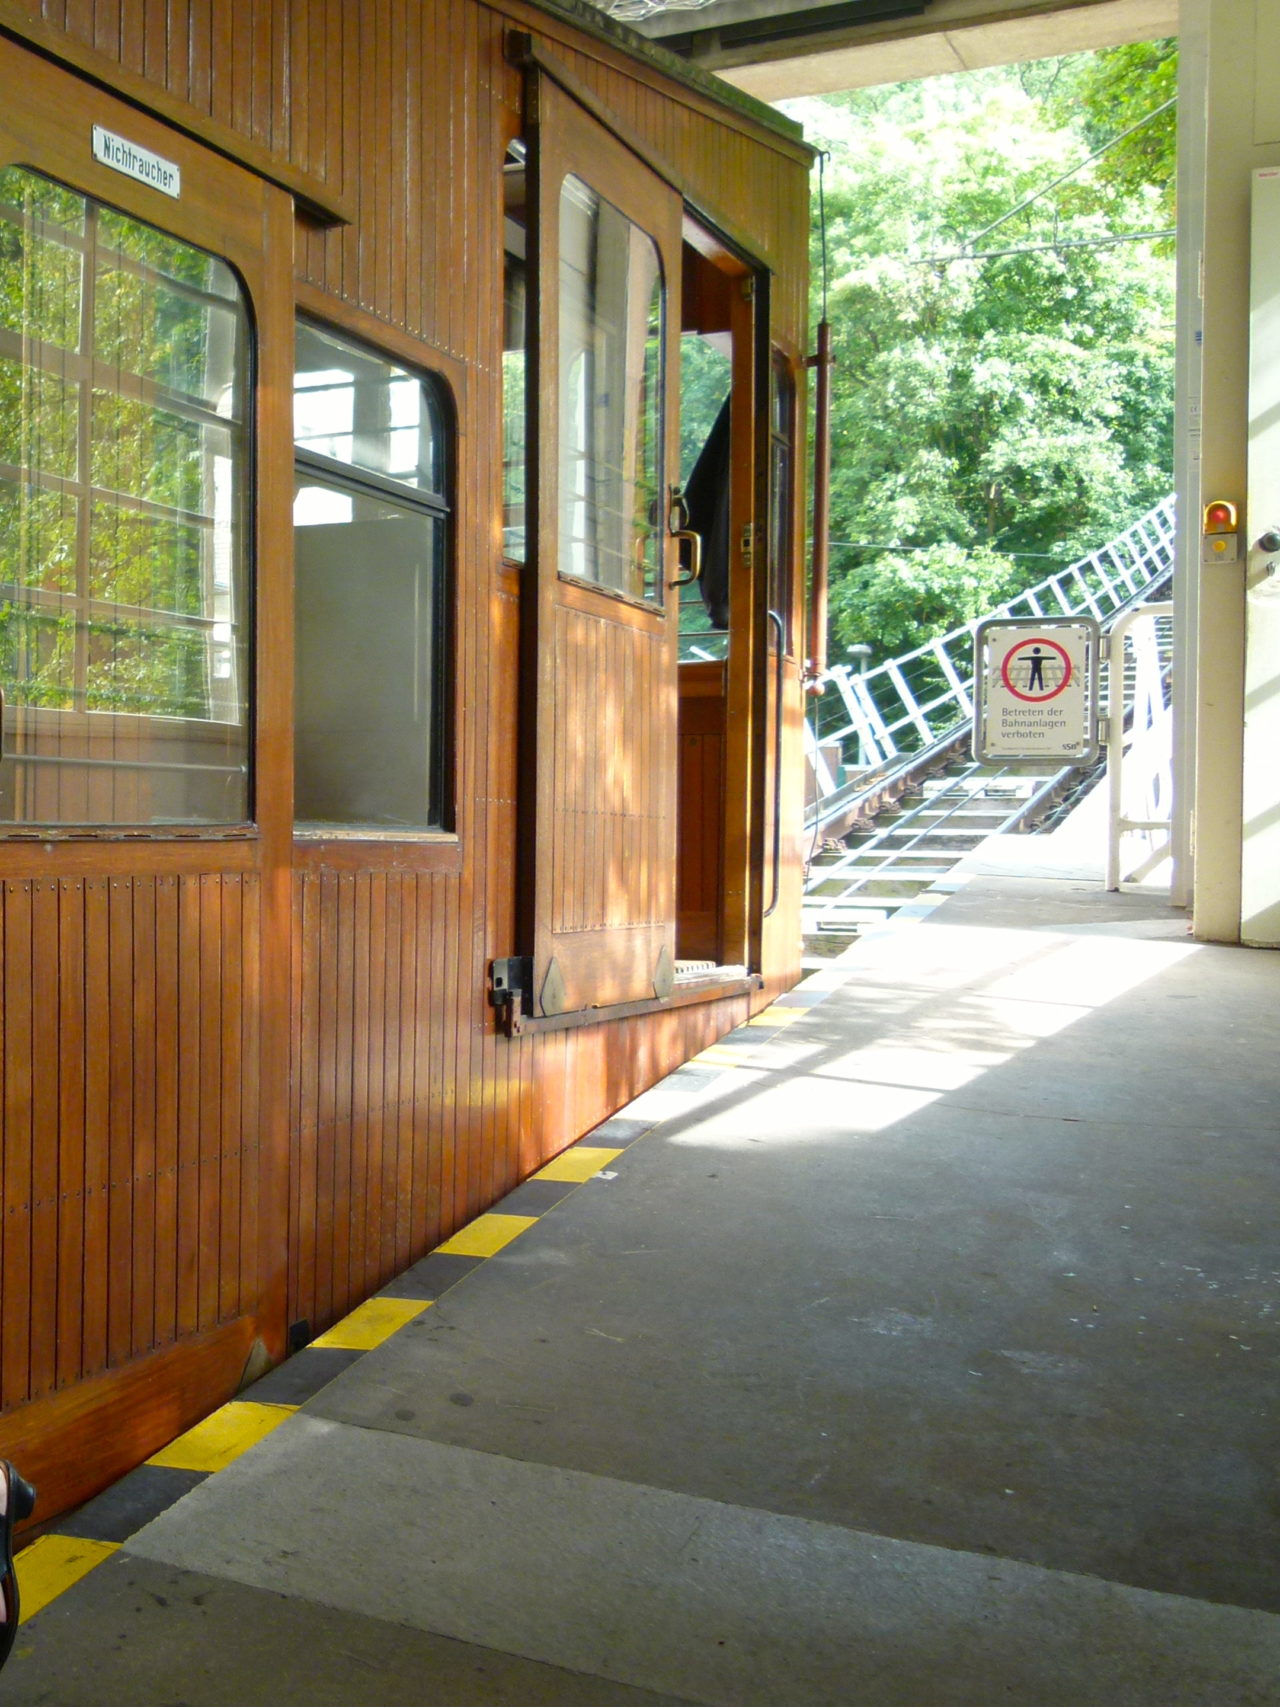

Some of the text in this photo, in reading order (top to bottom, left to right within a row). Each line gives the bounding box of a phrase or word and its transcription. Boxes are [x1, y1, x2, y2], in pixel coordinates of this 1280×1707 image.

[102, 134, 174, 189] Nichtraucher
[1002, 707, 1064, 717] Betreten der
[1002, 719, 1066, 729] Bahnanlagen
[1001, 730, 1045, 739] verboten
